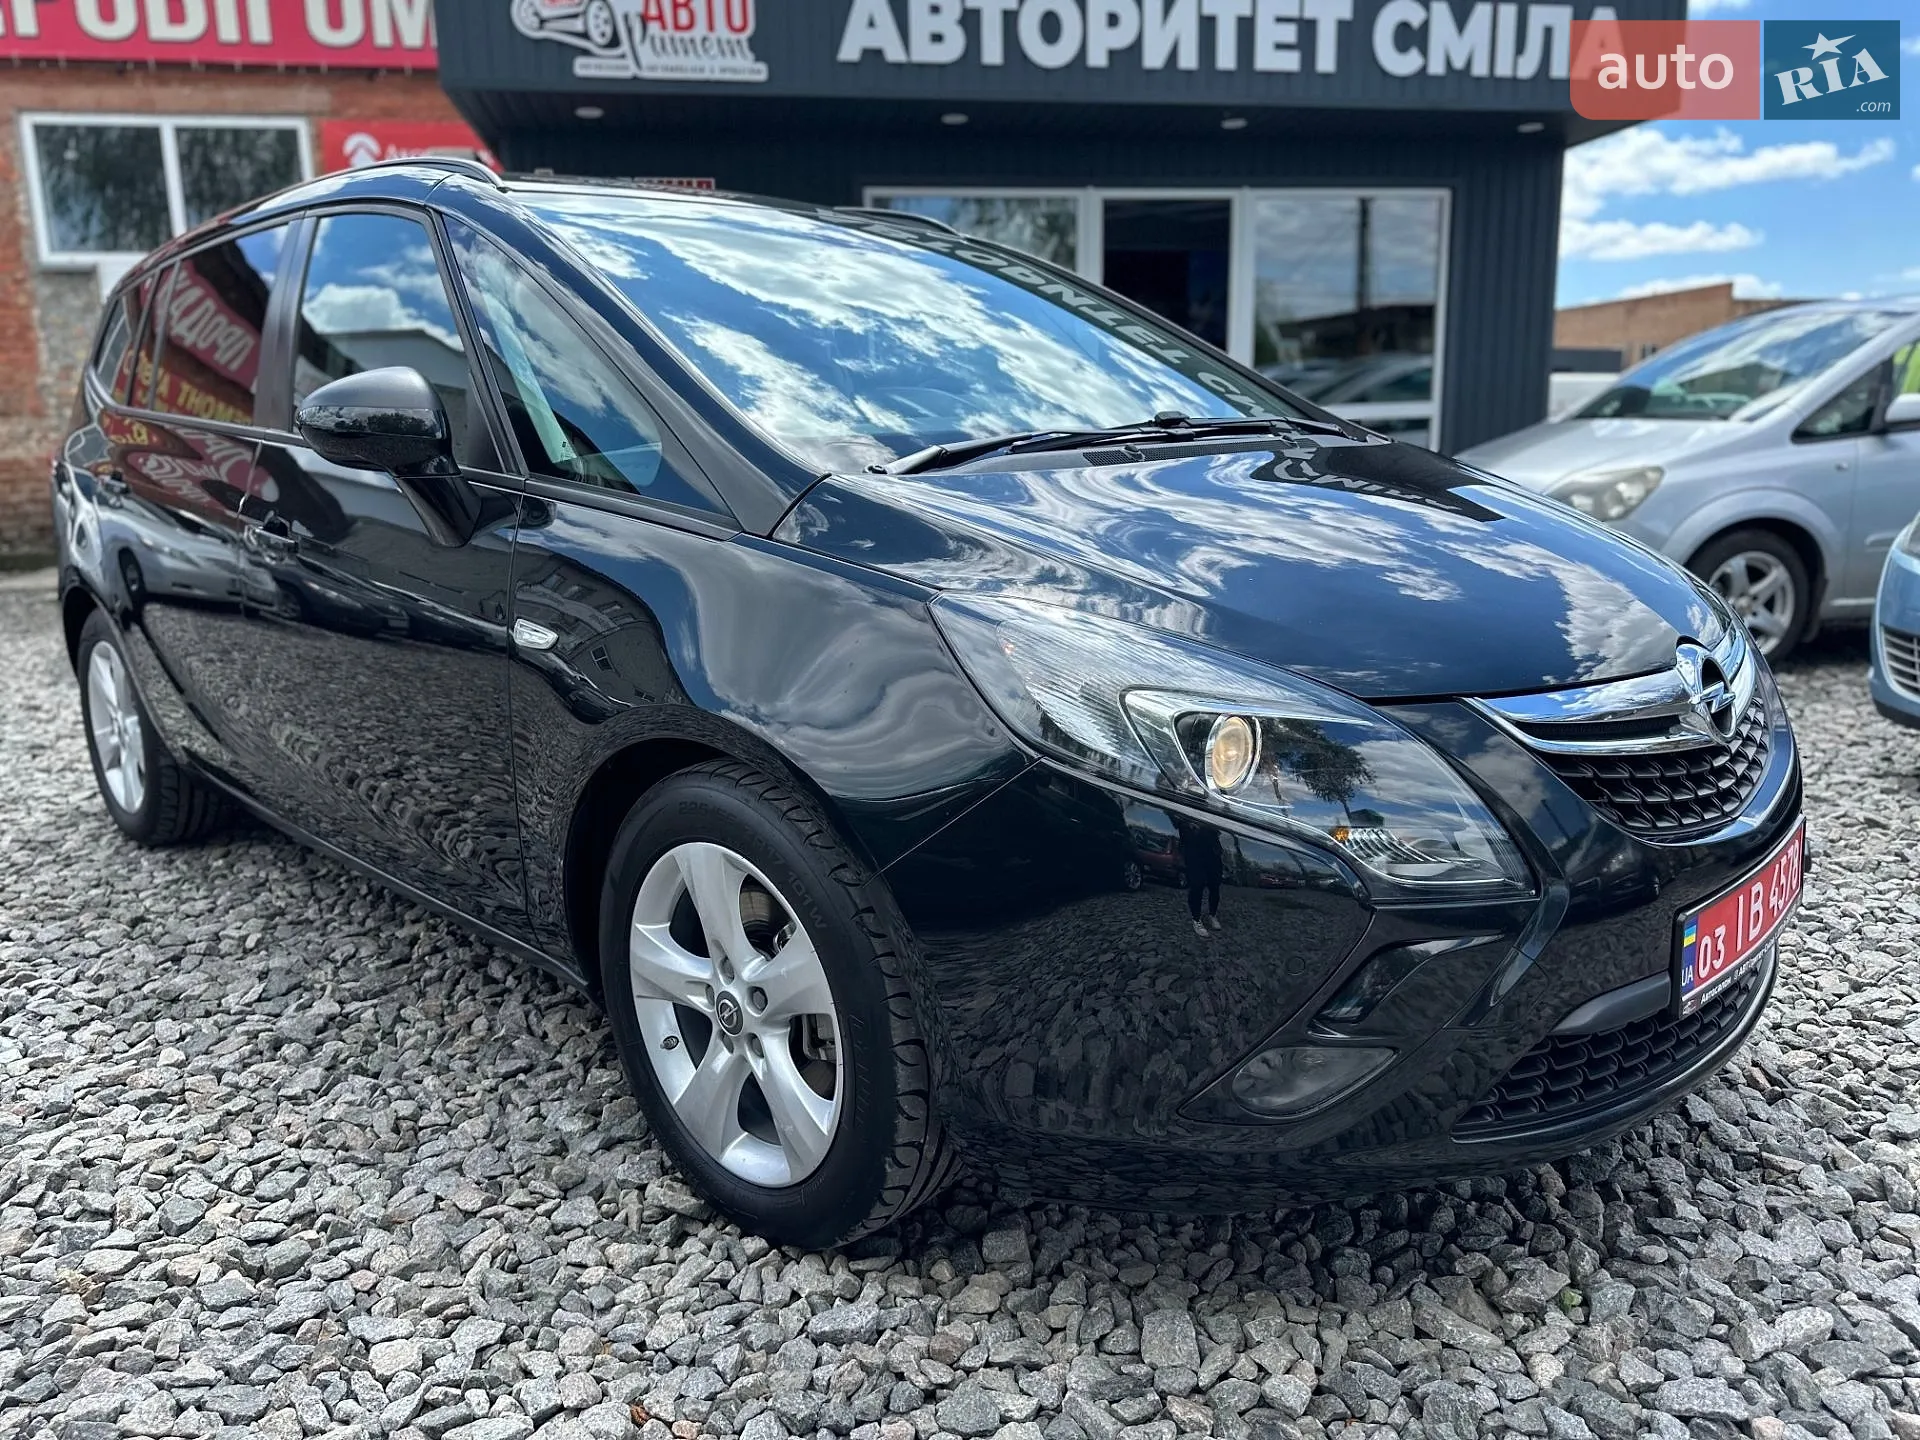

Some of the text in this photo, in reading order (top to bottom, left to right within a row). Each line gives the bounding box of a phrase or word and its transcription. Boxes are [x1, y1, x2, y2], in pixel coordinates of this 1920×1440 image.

[836, 0, 1630, 81] АВТОРИТЕТ СМІЛА
[1698, 924, 1726, 979] 03
[1769, 839, 1800, 918] 4578
[1681, 965, 1694, 987] UA
